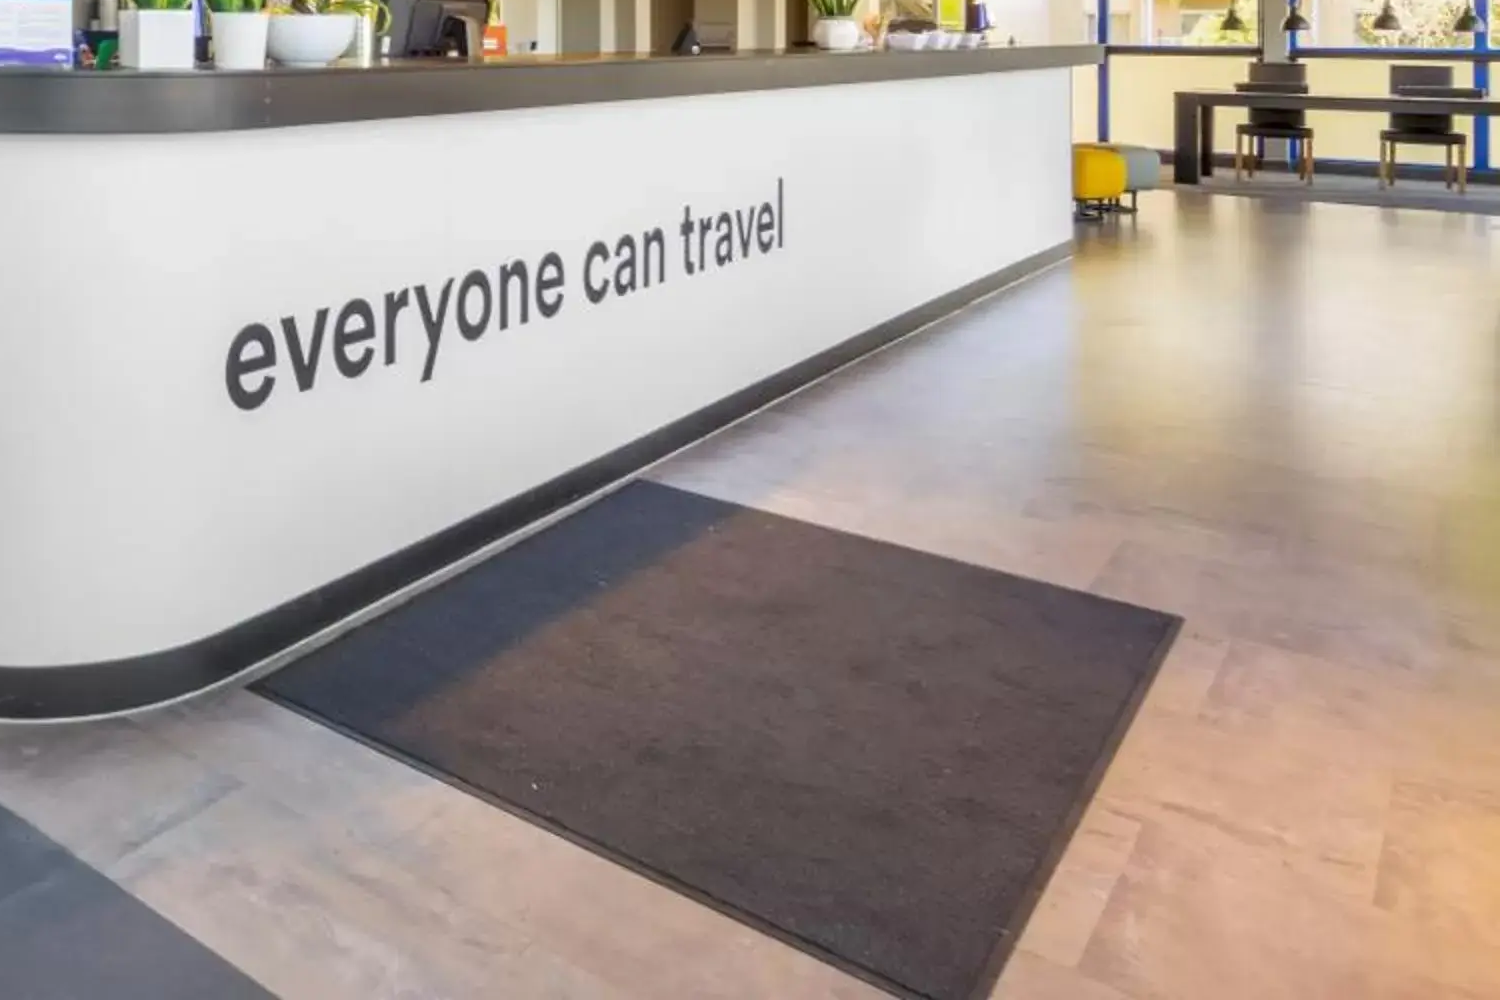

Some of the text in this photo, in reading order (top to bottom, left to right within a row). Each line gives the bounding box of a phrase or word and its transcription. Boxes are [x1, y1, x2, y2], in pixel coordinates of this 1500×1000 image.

[224, 176, 784, 411] everyone can travel
